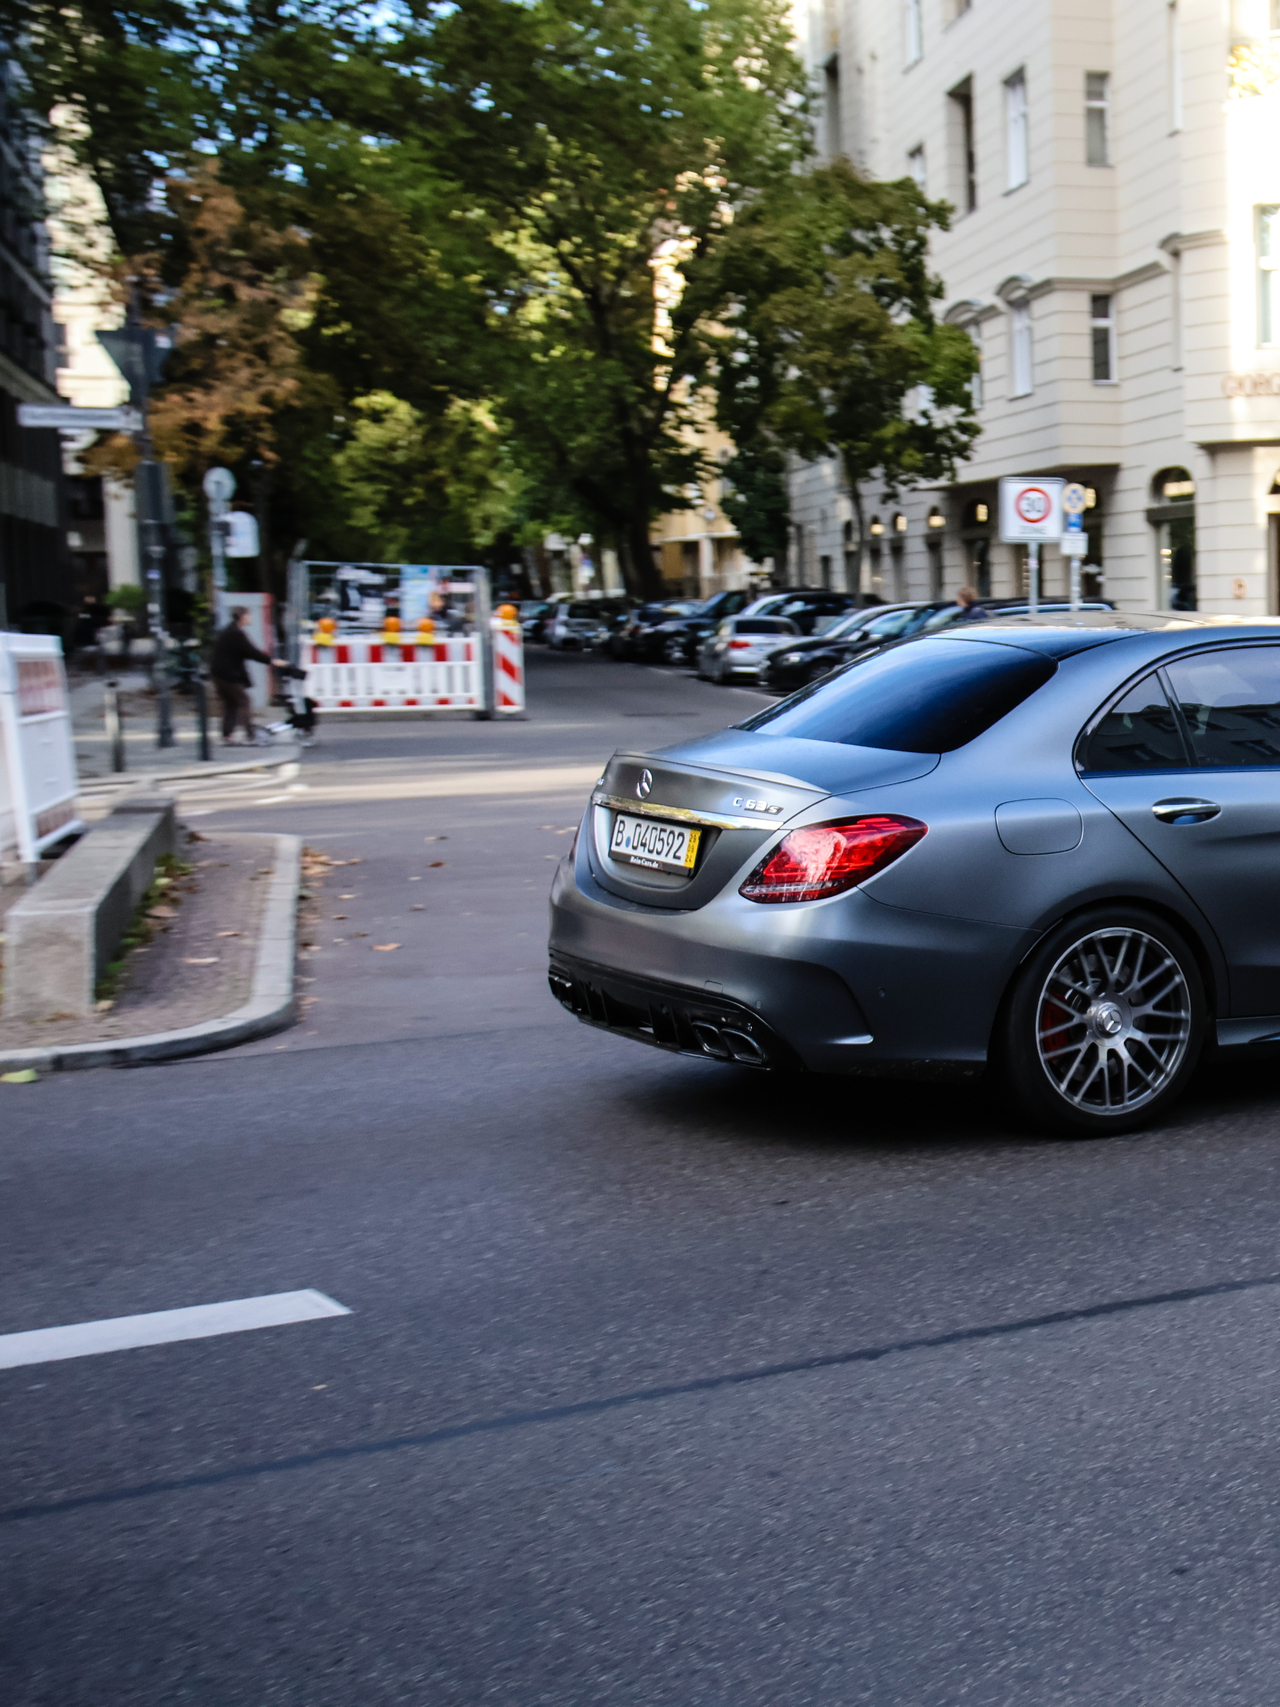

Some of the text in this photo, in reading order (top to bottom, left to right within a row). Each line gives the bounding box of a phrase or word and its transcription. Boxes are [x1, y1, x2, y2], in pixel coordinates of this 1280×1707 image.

[1022, 496, 1046, 513] 30
[614, 819, 685, 860] B 040592
